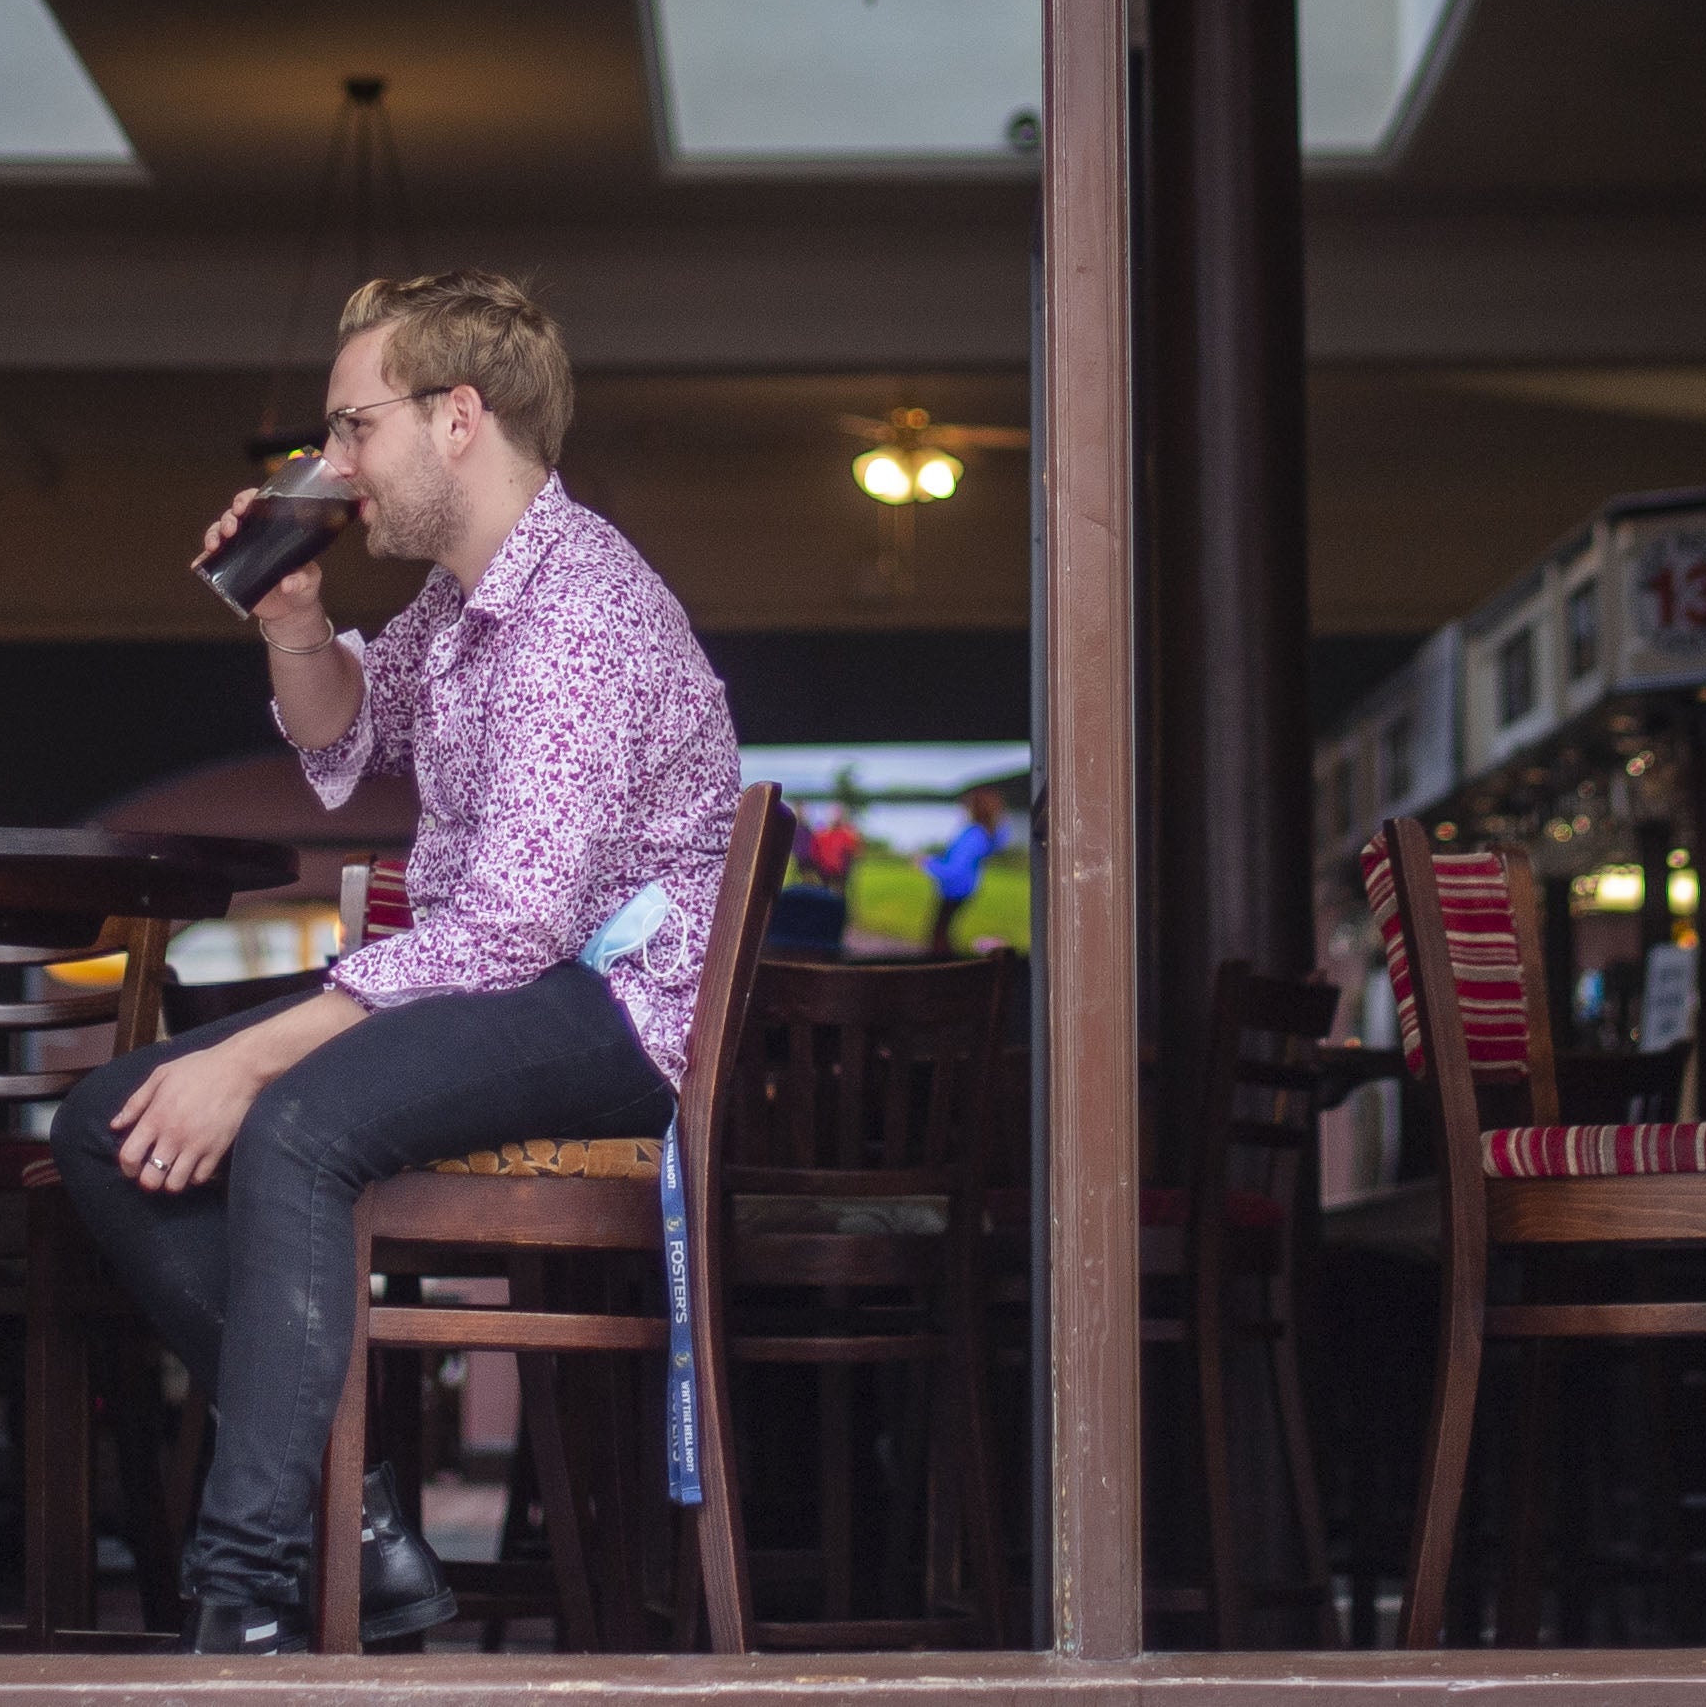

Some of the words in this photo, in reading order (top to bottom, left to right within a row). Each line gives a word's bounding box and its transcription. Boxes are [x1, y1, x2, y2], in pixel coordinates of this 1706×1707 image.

[669, 1239, 688, 1324] FOSTER'S
[680, 1380, 692, 1405] WHY
[682, 1404, 693, 1424] THE
[683, 1424, 694, 1447] HELL
